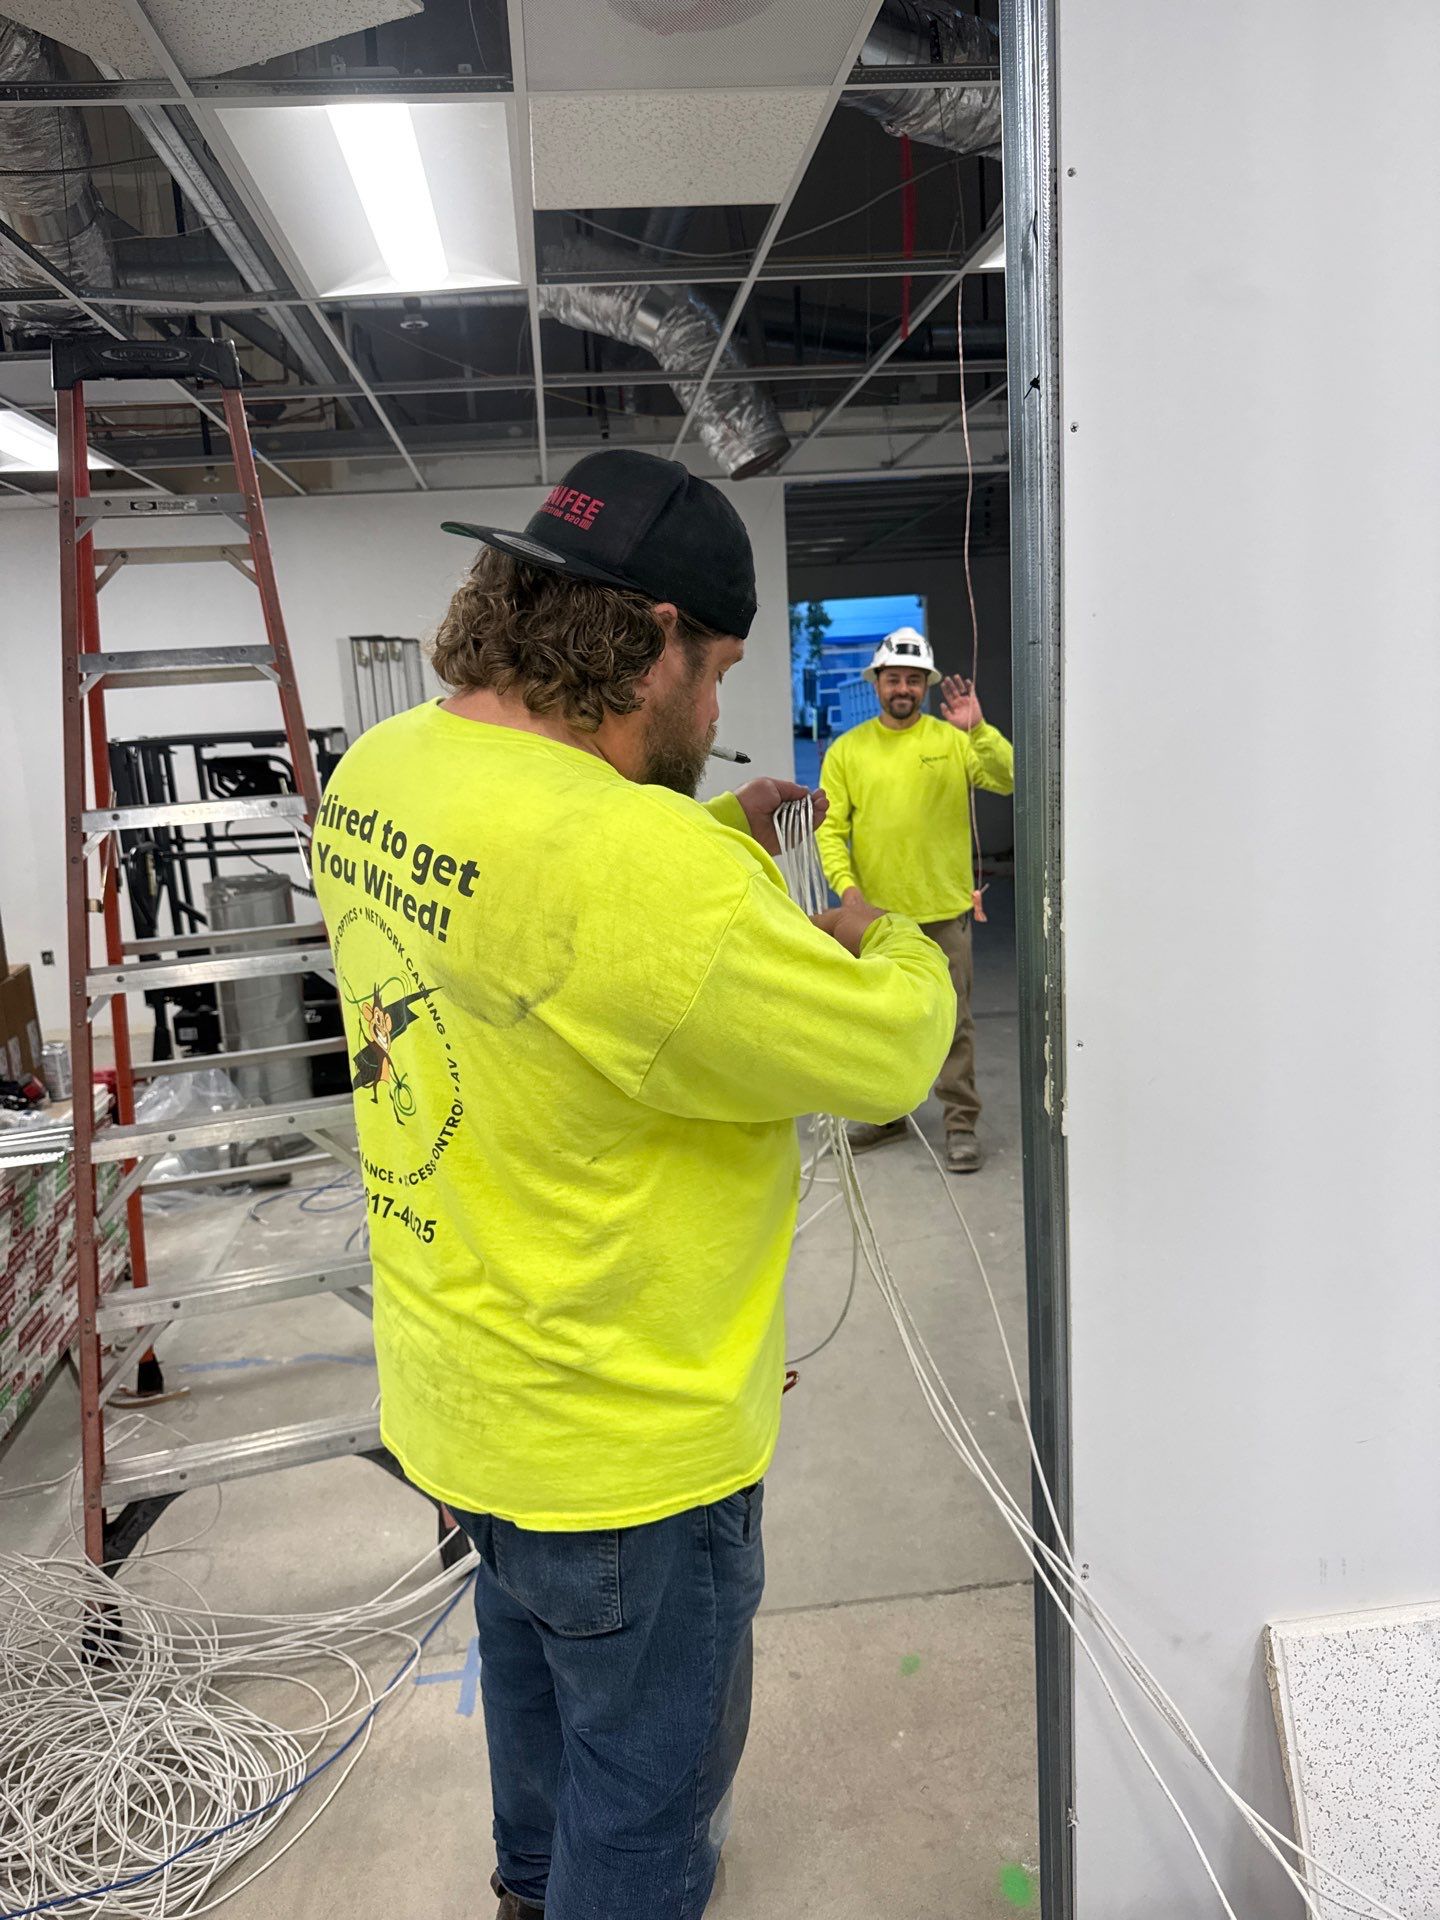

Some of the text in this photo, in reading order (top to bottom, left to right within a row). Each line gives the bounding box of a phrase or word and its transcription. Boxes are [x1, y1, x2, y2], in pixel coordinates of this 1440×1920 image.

[317, 794, 481, 898] Hired to get
[317, 842, 452, 943] You Wired!
[337, 907, 358, 938] OPTICS
[365, 907, 405, 960] NETWORK
